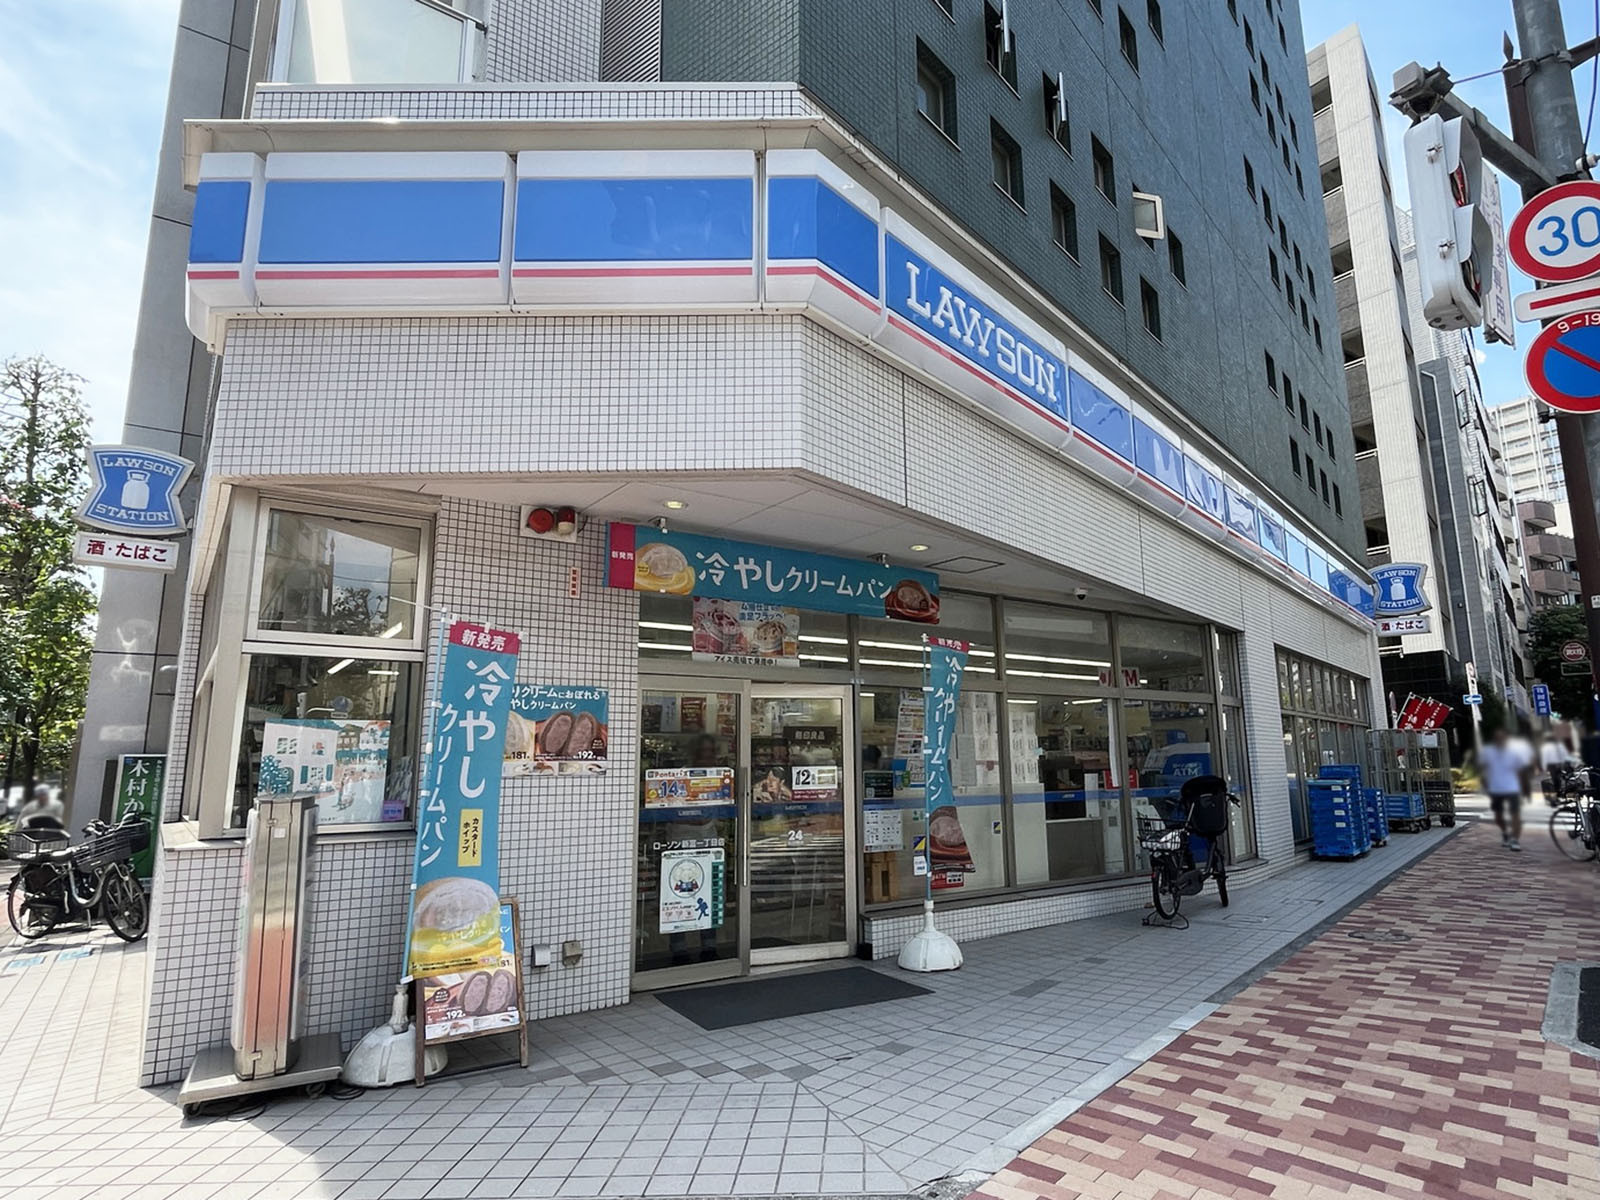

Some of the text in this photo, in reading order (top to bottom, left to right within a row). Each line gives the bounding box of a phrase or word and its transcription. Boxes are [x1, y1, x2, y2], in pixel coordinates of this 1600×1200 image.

[1536, 206, 1600, 257] 30
[906, 261, 1057, 402] LAWSON
[1557, 313, 1600, 333] 9-19
[102, 457, 176, 477] LAWSON
[95, 503, 169, 521] STATION
[86, 539, 168, 562] 酒・たばこ
[695, 551, 893, 599] 冷やしクリームパン
[1377, 569, 1417, 580] LAWSON
[1380, 597, 1420, 608] STATION
[1381, 620, 1424, 631] 酒・たばこ
[461, 629, 507, 651] 新発売
[459, 659, 510, 799] 冷やし
[421, 703, 459, 868] クリームパン
[462, 822, 471, 854] ホイップ
[471, 817, 480, 858] カスタード
[788, 830, 804, 841] 24
